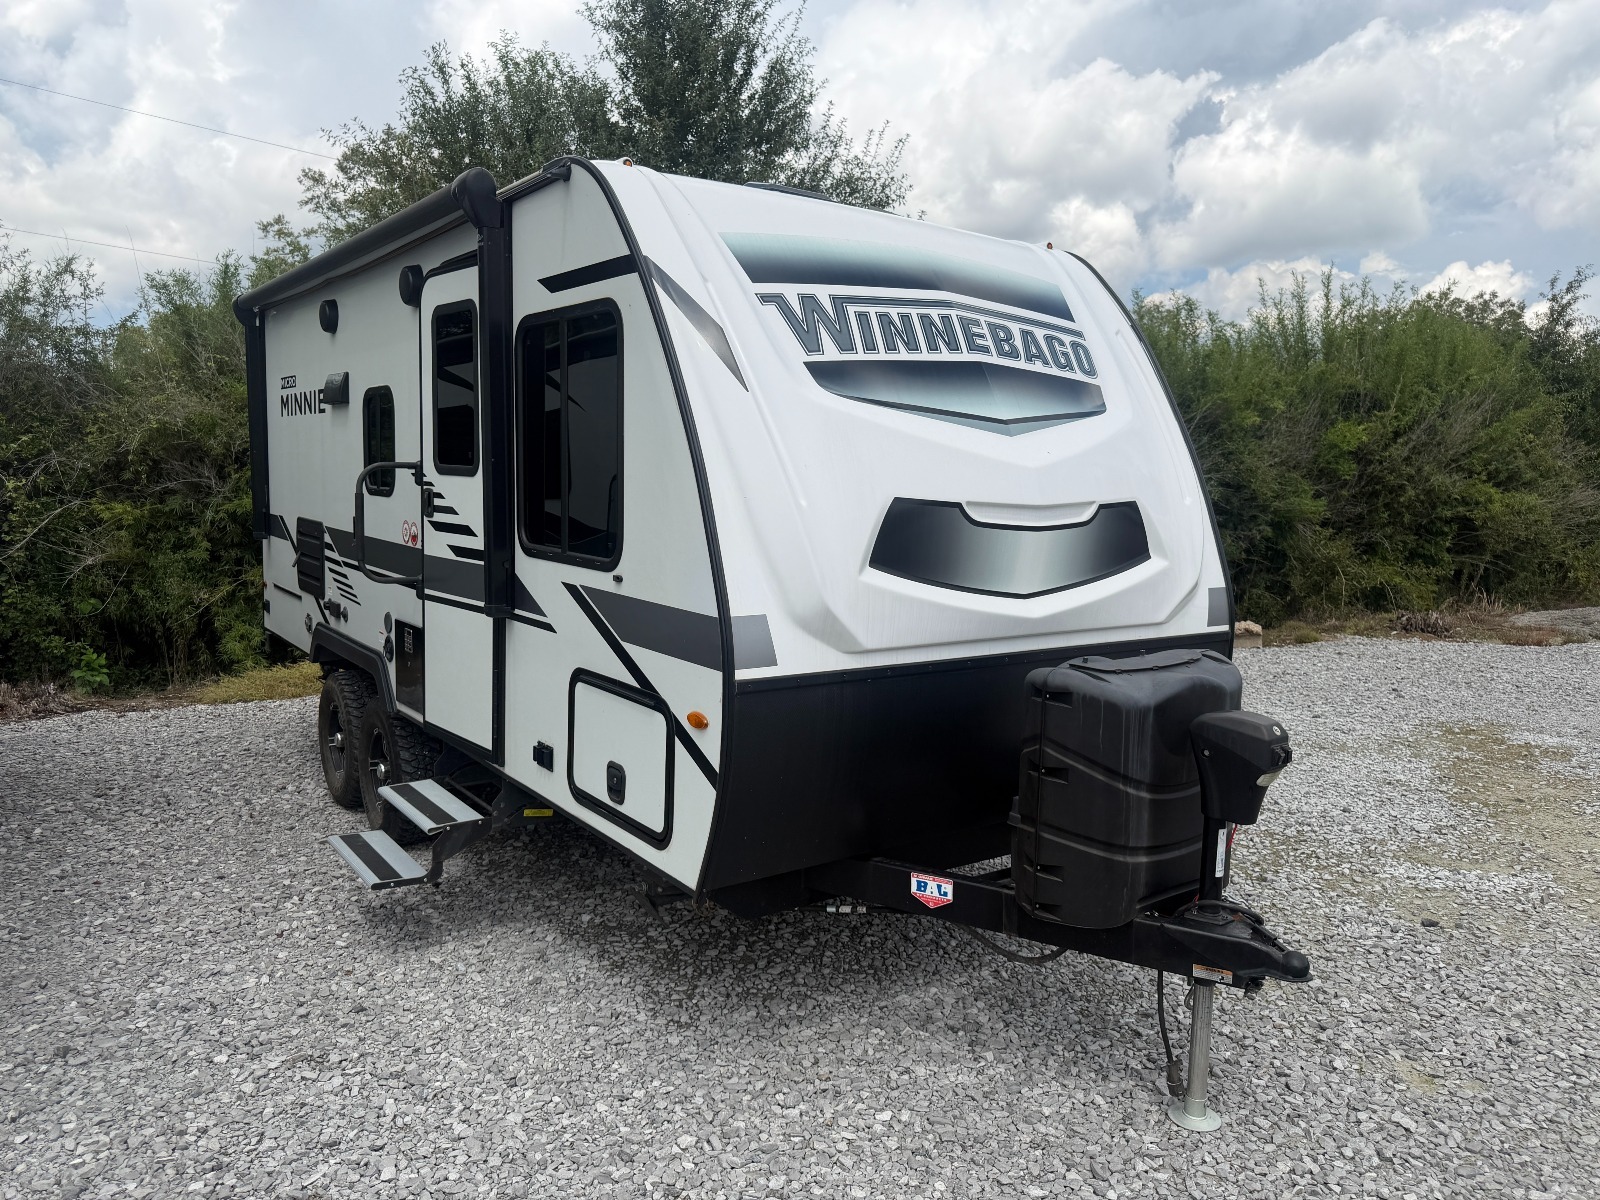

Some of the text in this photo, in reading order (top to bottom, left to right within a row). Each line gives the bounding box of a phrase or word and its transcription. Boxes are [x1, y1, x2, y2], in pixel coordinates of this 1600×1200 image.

[754, 293, 1099, 379] WINNEBAGO
[280, 375, 296, 389] MICRO
[280, 388, 326, 417] MINNIE
[915, 879, 948, 898] BAL
